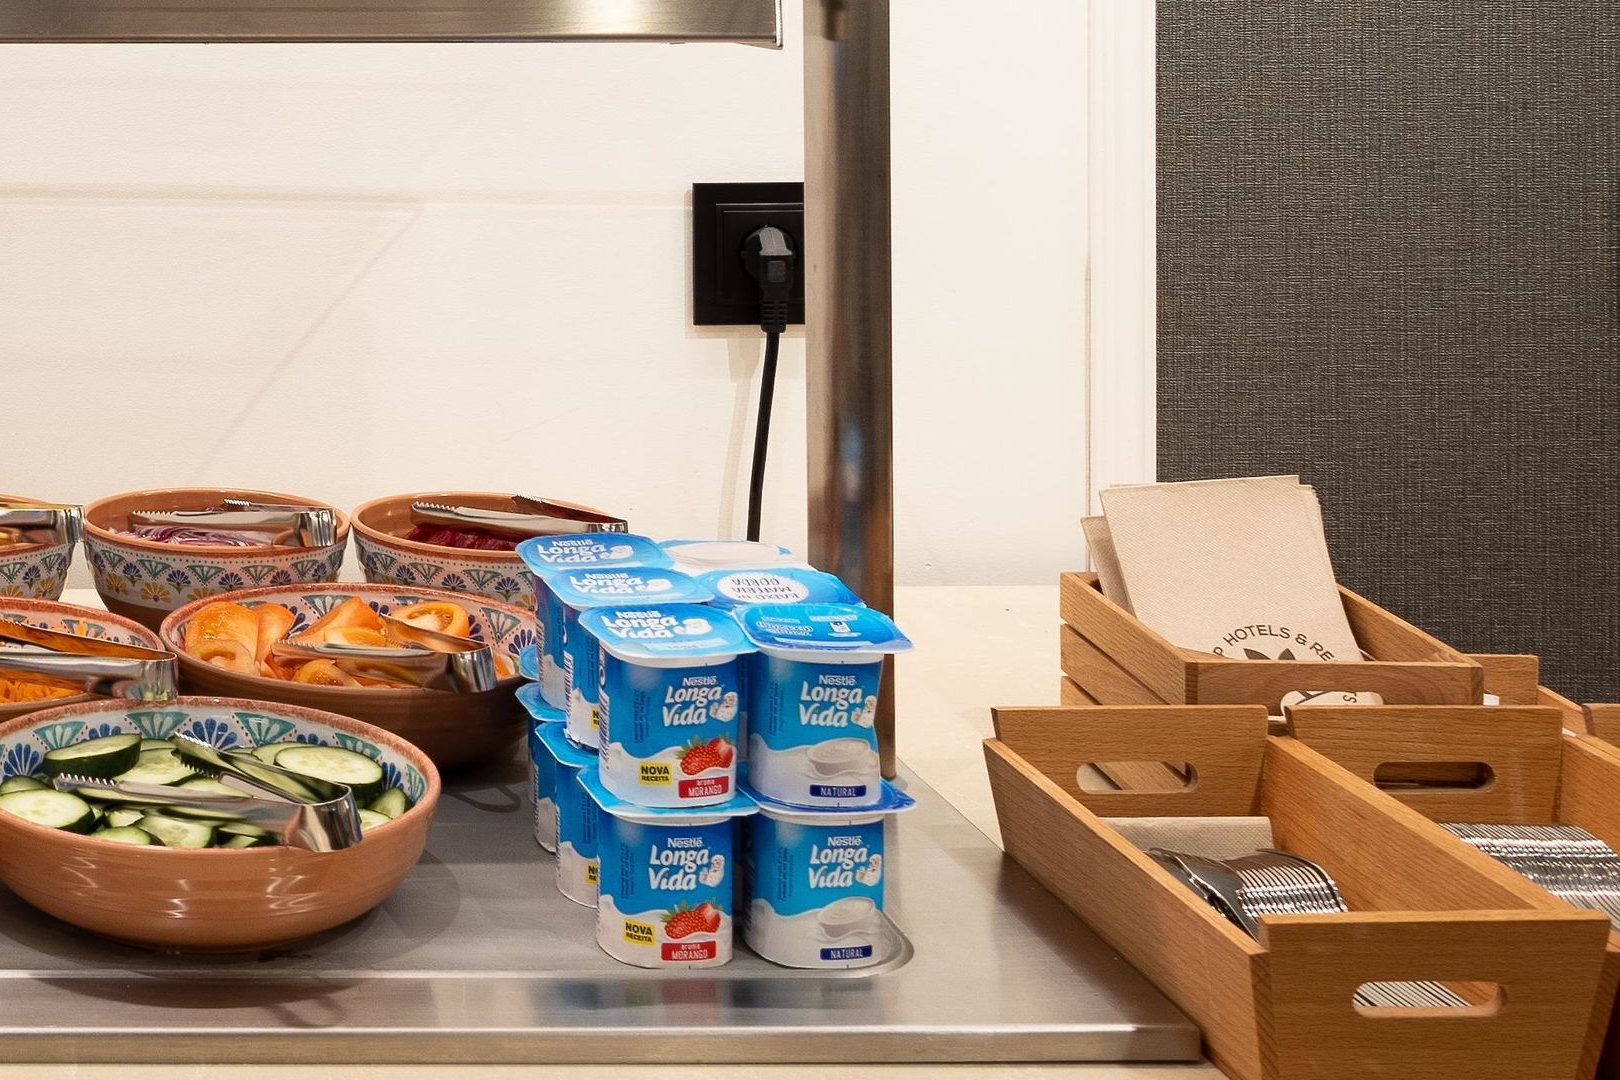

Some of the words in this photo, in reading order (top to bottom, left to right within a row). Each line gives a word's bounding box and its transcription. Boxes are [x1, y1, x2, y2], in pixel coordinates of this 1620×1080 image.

[537, 543, 606, 557] Longa
[540, 554, 598, 563] Vida
[570, 575, 642, 588] Longa
[573, 584, 634, 594] Vida
[601, 615, 678, 631] Longa
[608, 627, 675, 639] Vida
[1222, 624, 1290, 646] HOTELS
[1295, 633, 1308, 646] &
[1309, 641, 1338, 661] RE
[665, 685, 722, 707] Longa
[800, 681, 863, 710] Longa
[662, 704, 708, 727] Vida
[798, 703, 849, 727] Vida
[640, 766, 670, 775] NOVA
[688, 785, 723, 797] MORANGO
[821, 787, 857, 797] NATURAL
[650, 844, 709, 873] Longa
[809, 844, 868, 869] Longa
[648, 867, 697, 891] Vida
[808, 865, 854, 889] Vida
[625, 922, 653, 936] NOVA
[626, 933, 653, 942] RECEITA
[671, 949, 708, 960] MORANGO
[830, 948, 863, 959] NATURAL
